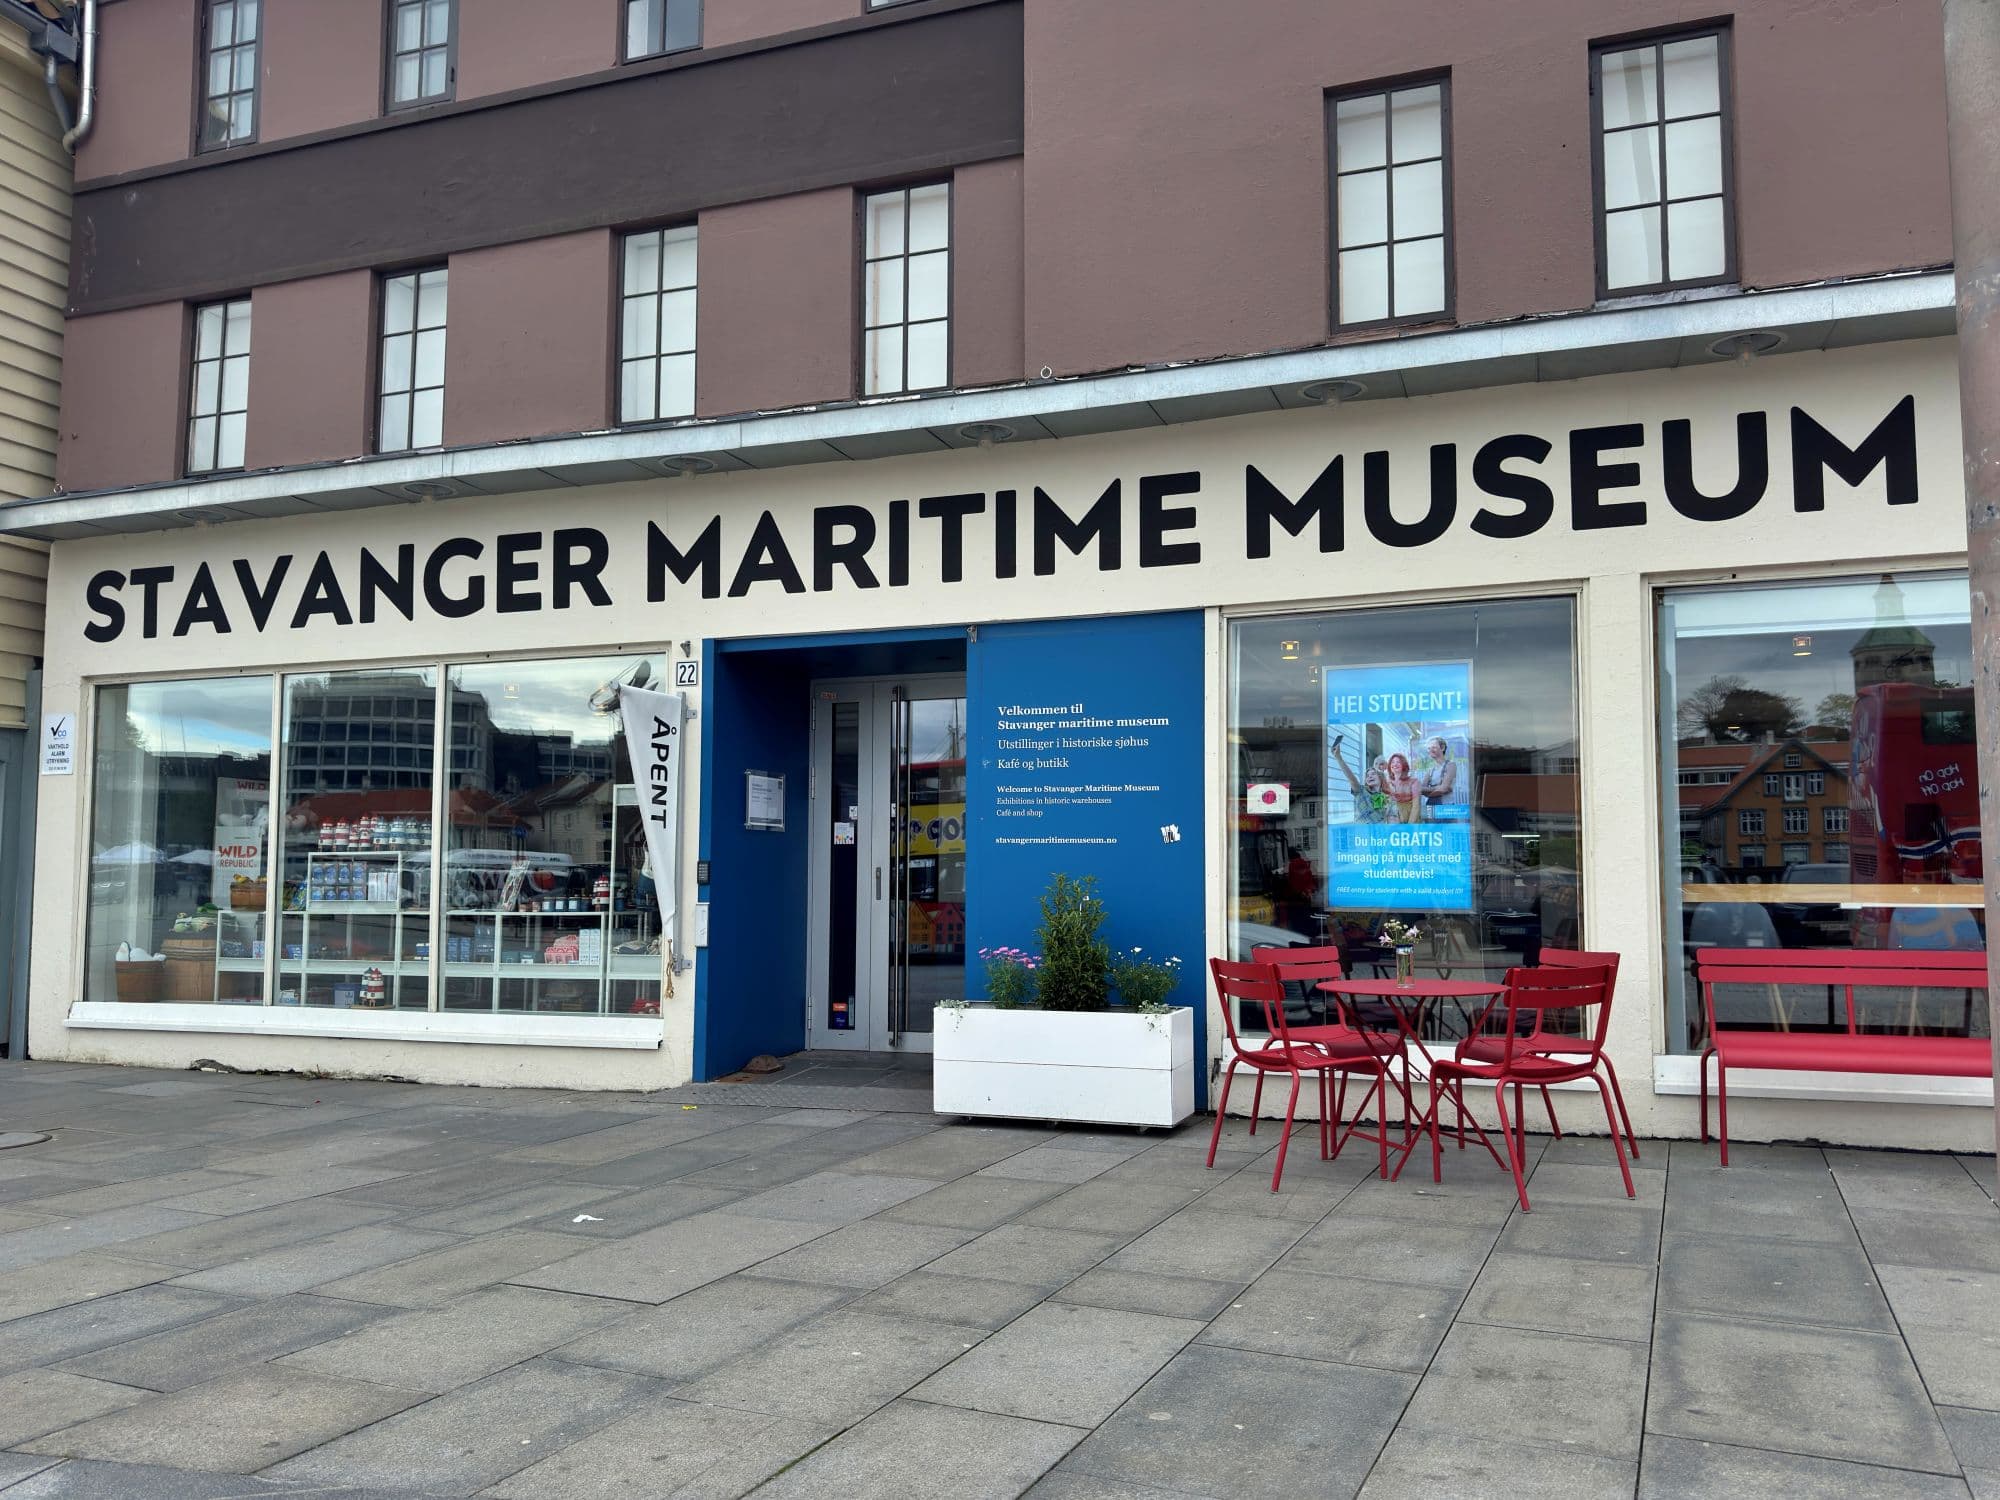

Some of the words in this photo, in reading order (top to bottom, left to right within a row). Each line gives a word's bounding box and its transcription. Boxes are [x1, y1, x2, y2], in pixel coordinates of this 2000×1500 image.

[84, 527, 612, 643] STAVANGER
[647, 471, 1201, 603] MARITIME
[1245, 394, 1919, 560] MUSEUM
[678, 664, 696, 684] 22
[1333, 695, 1362, 714] HEI
[1368, 690, 1462, 712] STUDENT!
[997, 705, 1068, 716] Velkommen
[1070, 703, 1084, 714] til
[997, 720, 1056, 731] Stavanger
[1058, 717, 1114, 728] maritime
[1116, 718, 1169, 727] museum
[998, 738, 1054, 750] Utstillinger
[1056, 738, 1060, 748] i
[1062, 737, 1113, 748] historiske
[1115, 736, 1149, 749] sjøhus
[998, 758, 1020, 769] Kafé
[1022, 761, 1034, 770] og
[1037, 757, 1069, 769] butikk
[650, 715, 677, 829] ÅPENT
[236, 779, 266, 792] WILD
[997, 785, 1033, 793] Welcome
[1043, 785, 1084, 795] Stavanger
[1084, 784, 1122, 792] Maritime
[1124, 784, 1160, 792] Museum
[996, 797, 1035, 805] Exhibitions
[996, 809, 1012, 817] Café
[1012, 809, 1026, 817] and
[1026, 809, 1043, 818] shop
[995, 836, 1118, 845] stavangermaritimemuseum.no
[1354, 836, 1368, 847] Du
[1370, 836, 1387, 847] har
[1390, 831, 1443, 847] GRATIS
[218, 844, 258, 859] WILD
[1337, 851, 1379, 865] inngang
[1381, 851, 1394, 865] på
[1396, 852, 1435, 863] museet
[1437, 852, 1461, 863] med
[220, 858, 254, 869] REPUBLIC
[1363, 868, 1434, 879] studentbevis!
